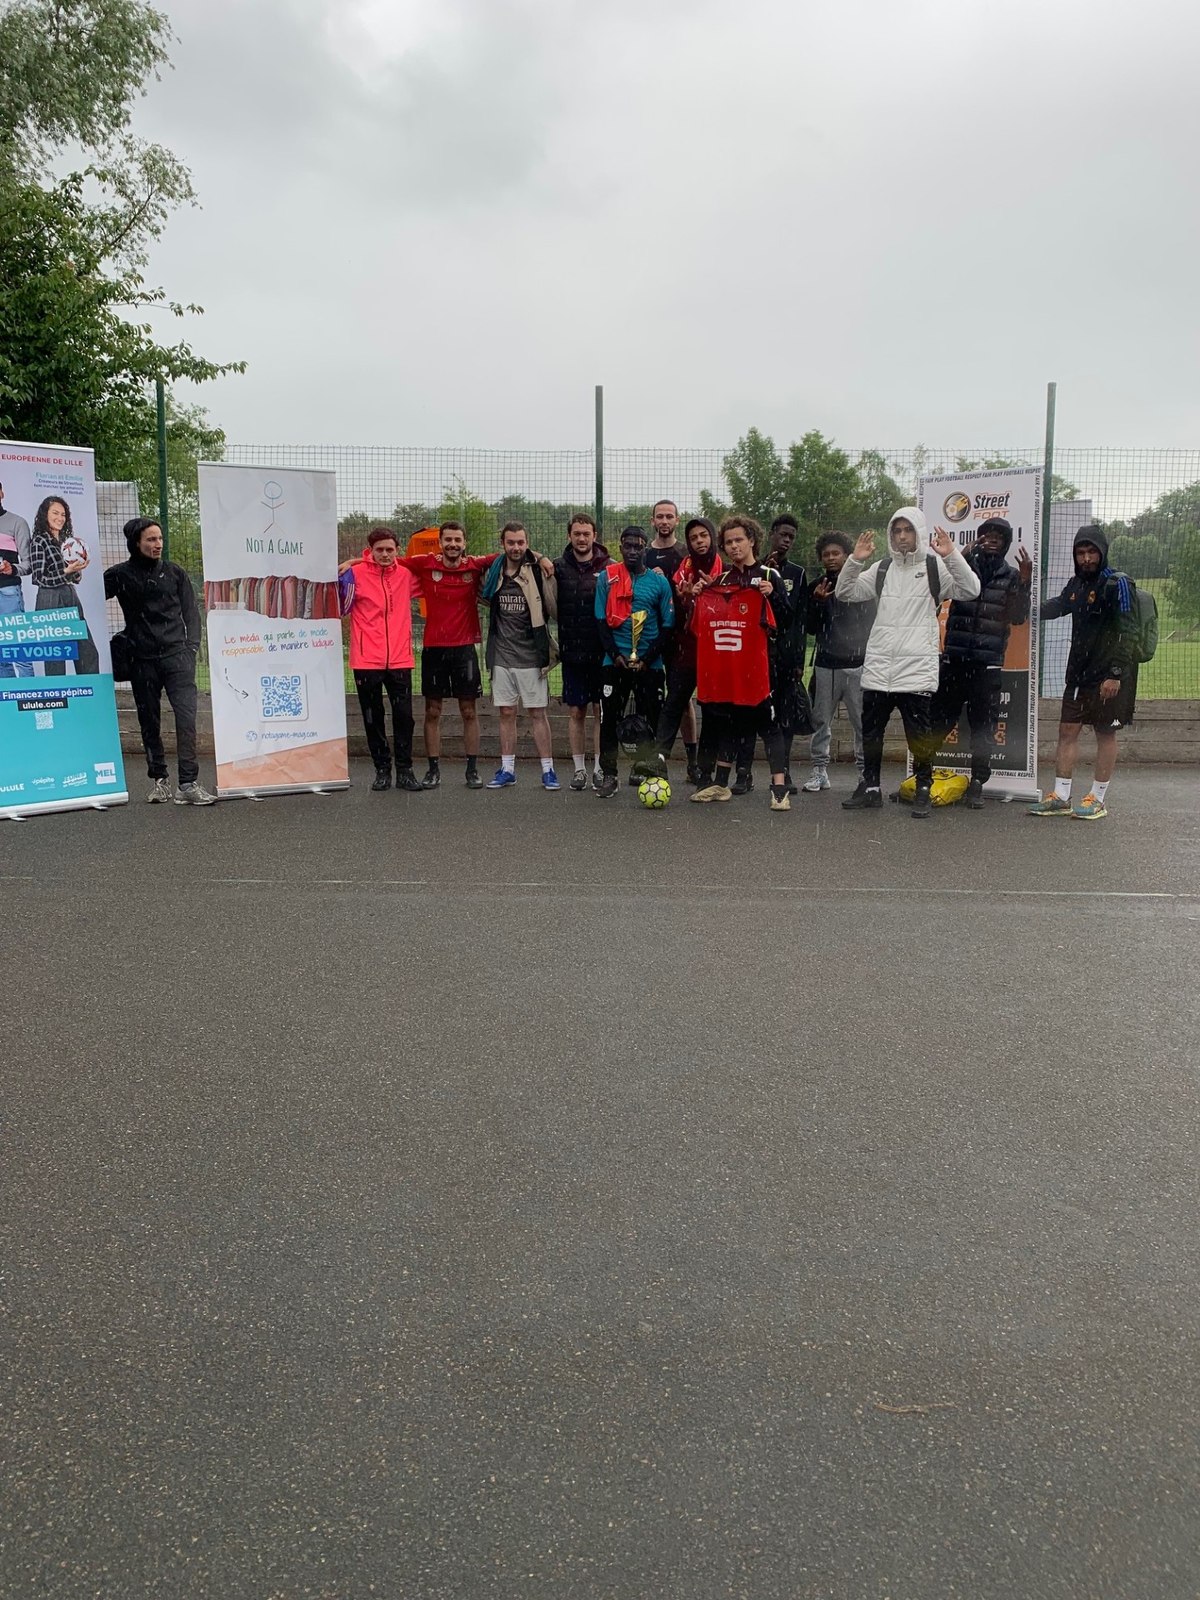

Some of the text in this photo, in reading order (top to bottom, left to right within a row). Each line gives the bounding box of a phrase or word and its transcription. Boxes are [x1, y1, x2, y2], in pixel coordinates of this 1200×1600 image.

[973, 492, 1010, 509] Street
[246, 537, 304, 556] NOT A GAME
[499, 594, 526, 604] mirate
[4, 614, 30, 627] MEL
[32, 610, 79, 624] soutient
[709, 620, 747, 628] SAMSIC
[0, 625, 83, 643] es pépites...
[224, 635, 236, 644] Le
[263, 634, 273, 643] qui
[276, 630, 295, 642] parle
[298, 629, 307, 638] de
[310, 627, 328, 637] mode
[1, 646, 72, 658] ET VOUS ?
[221, 645, 264, 657] responsable
[268, 643, 277, 652] de
[281, 641, 309, 650] manière
[2, 692, 43, 700] Financez
[61, 687, 93, 698] pépites
[22, 701, 64, 709] ulule.com
